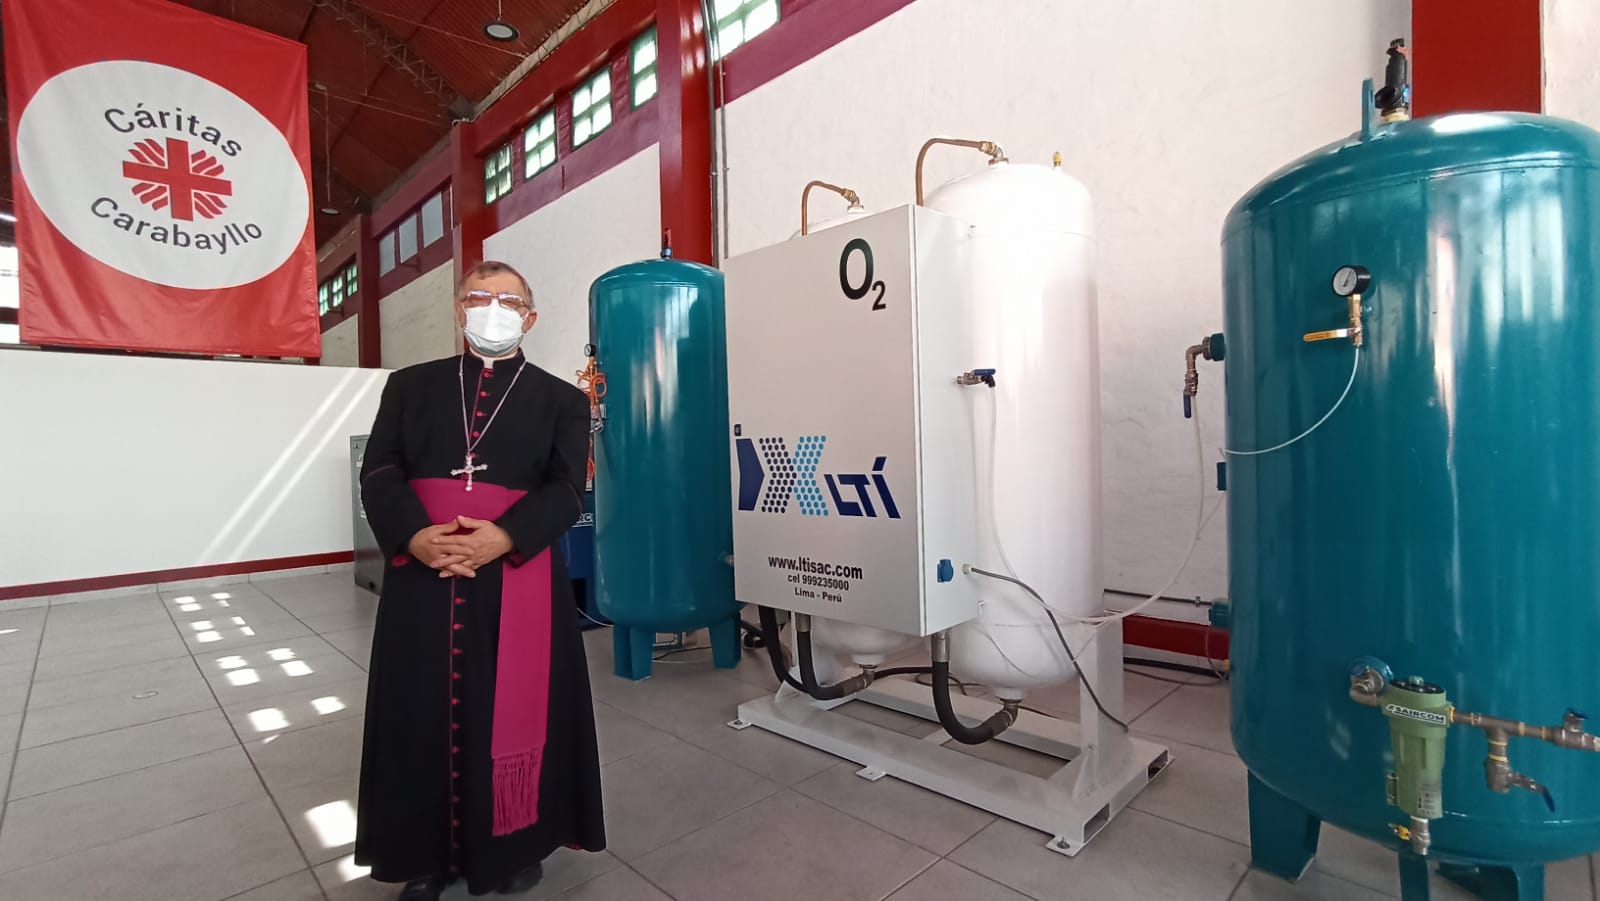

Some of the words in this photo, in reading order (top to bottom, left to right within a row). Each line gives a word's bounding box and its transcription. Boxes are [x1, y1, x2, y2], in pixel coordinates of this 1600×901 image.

[104, 103, 242, 156] Cáritas
[91, 197, 262, 254] Carabayllo
[768, 556, 863, 580] www.ltisac.com
[787, 573, 800, 583] cel
[802, 574, 849, 591] 999235000
[794, 587, 815, 598] Lima
[822, 591, 842, 603] Perú
